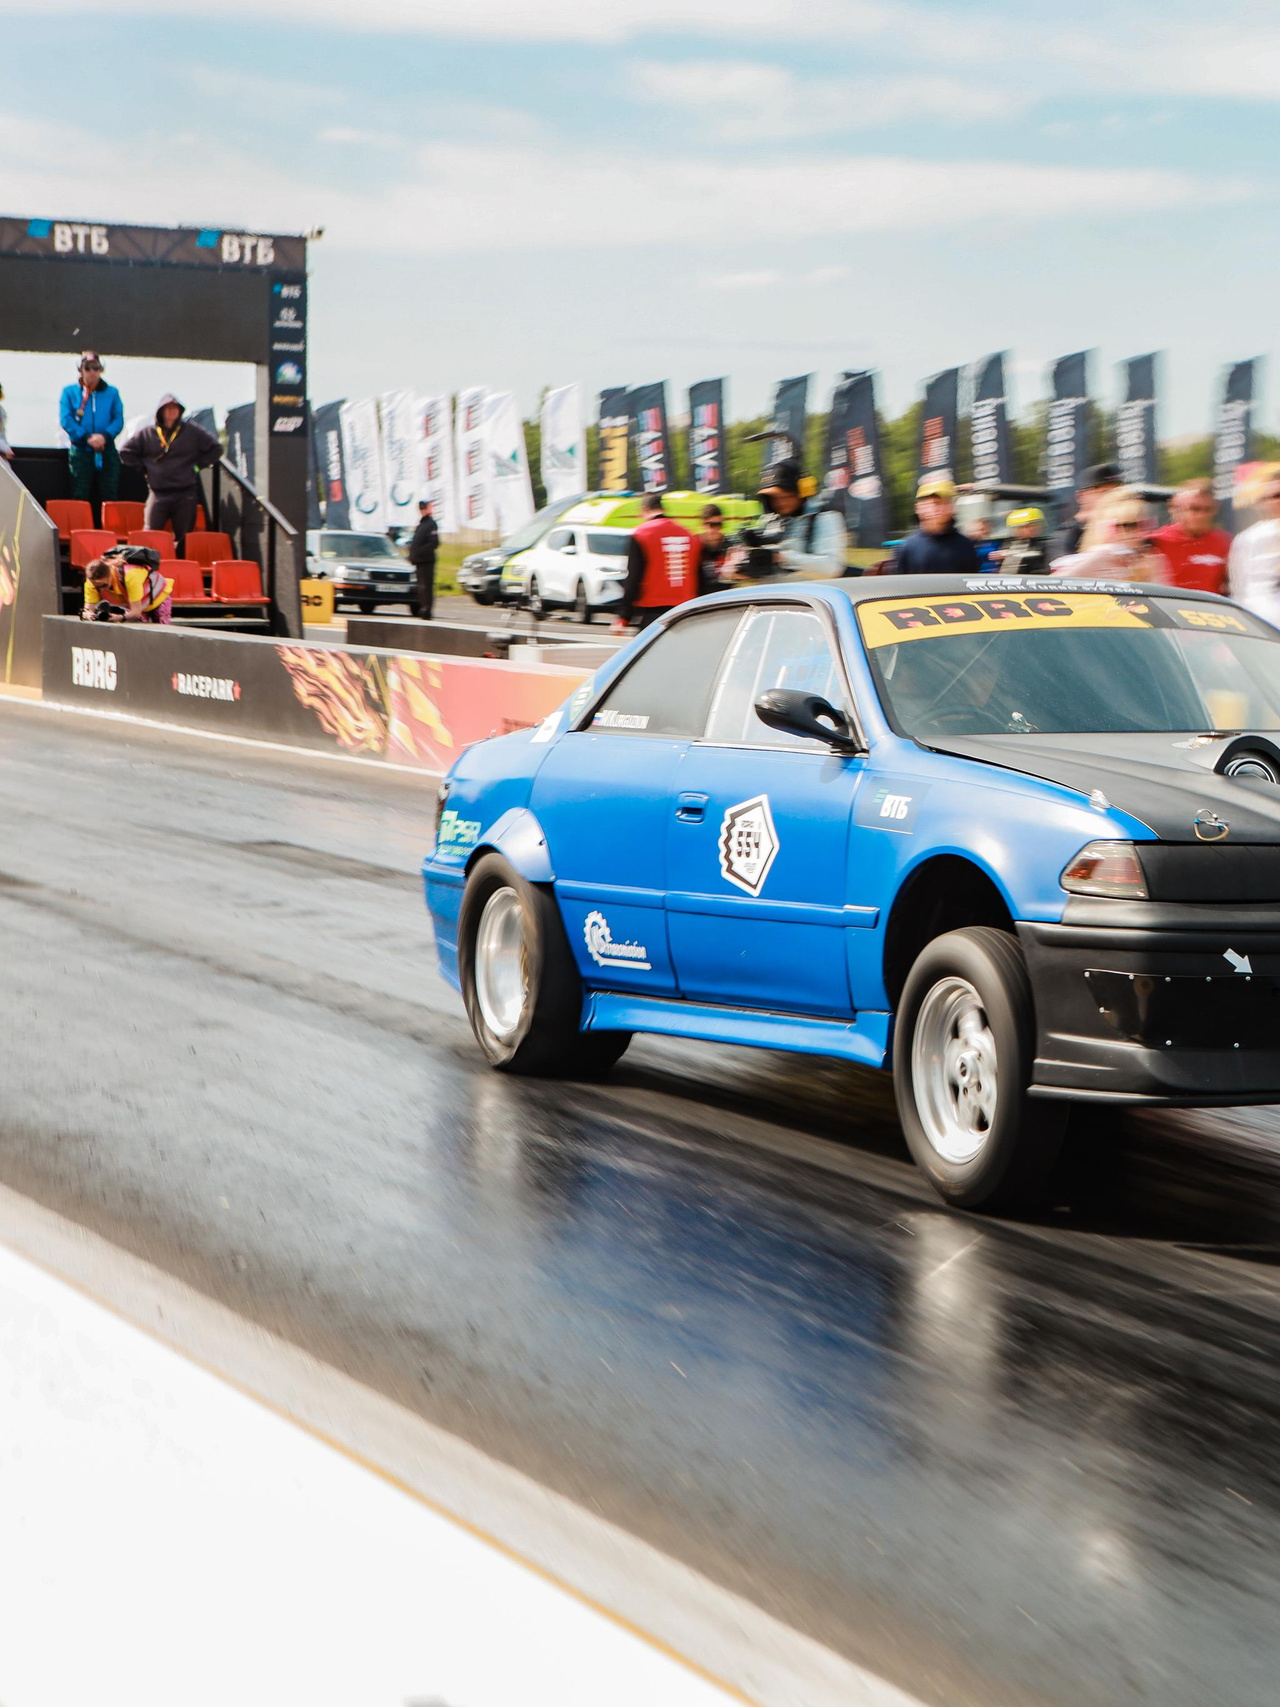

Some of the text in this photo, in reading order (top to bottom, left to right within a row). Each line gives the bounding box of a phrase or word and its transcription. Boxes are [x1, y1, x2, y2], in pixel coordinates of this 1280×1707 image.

[54, 223, 109, 255] ВТБ
[220, 234, 275, 266] ВТБ
[878, 598, 1075, 631] RDRC
[71, 646, 118, 692] RDRC
[176, 672, 236, 702] RACEPARK
[879, 794, 913, 820] ВТБ
